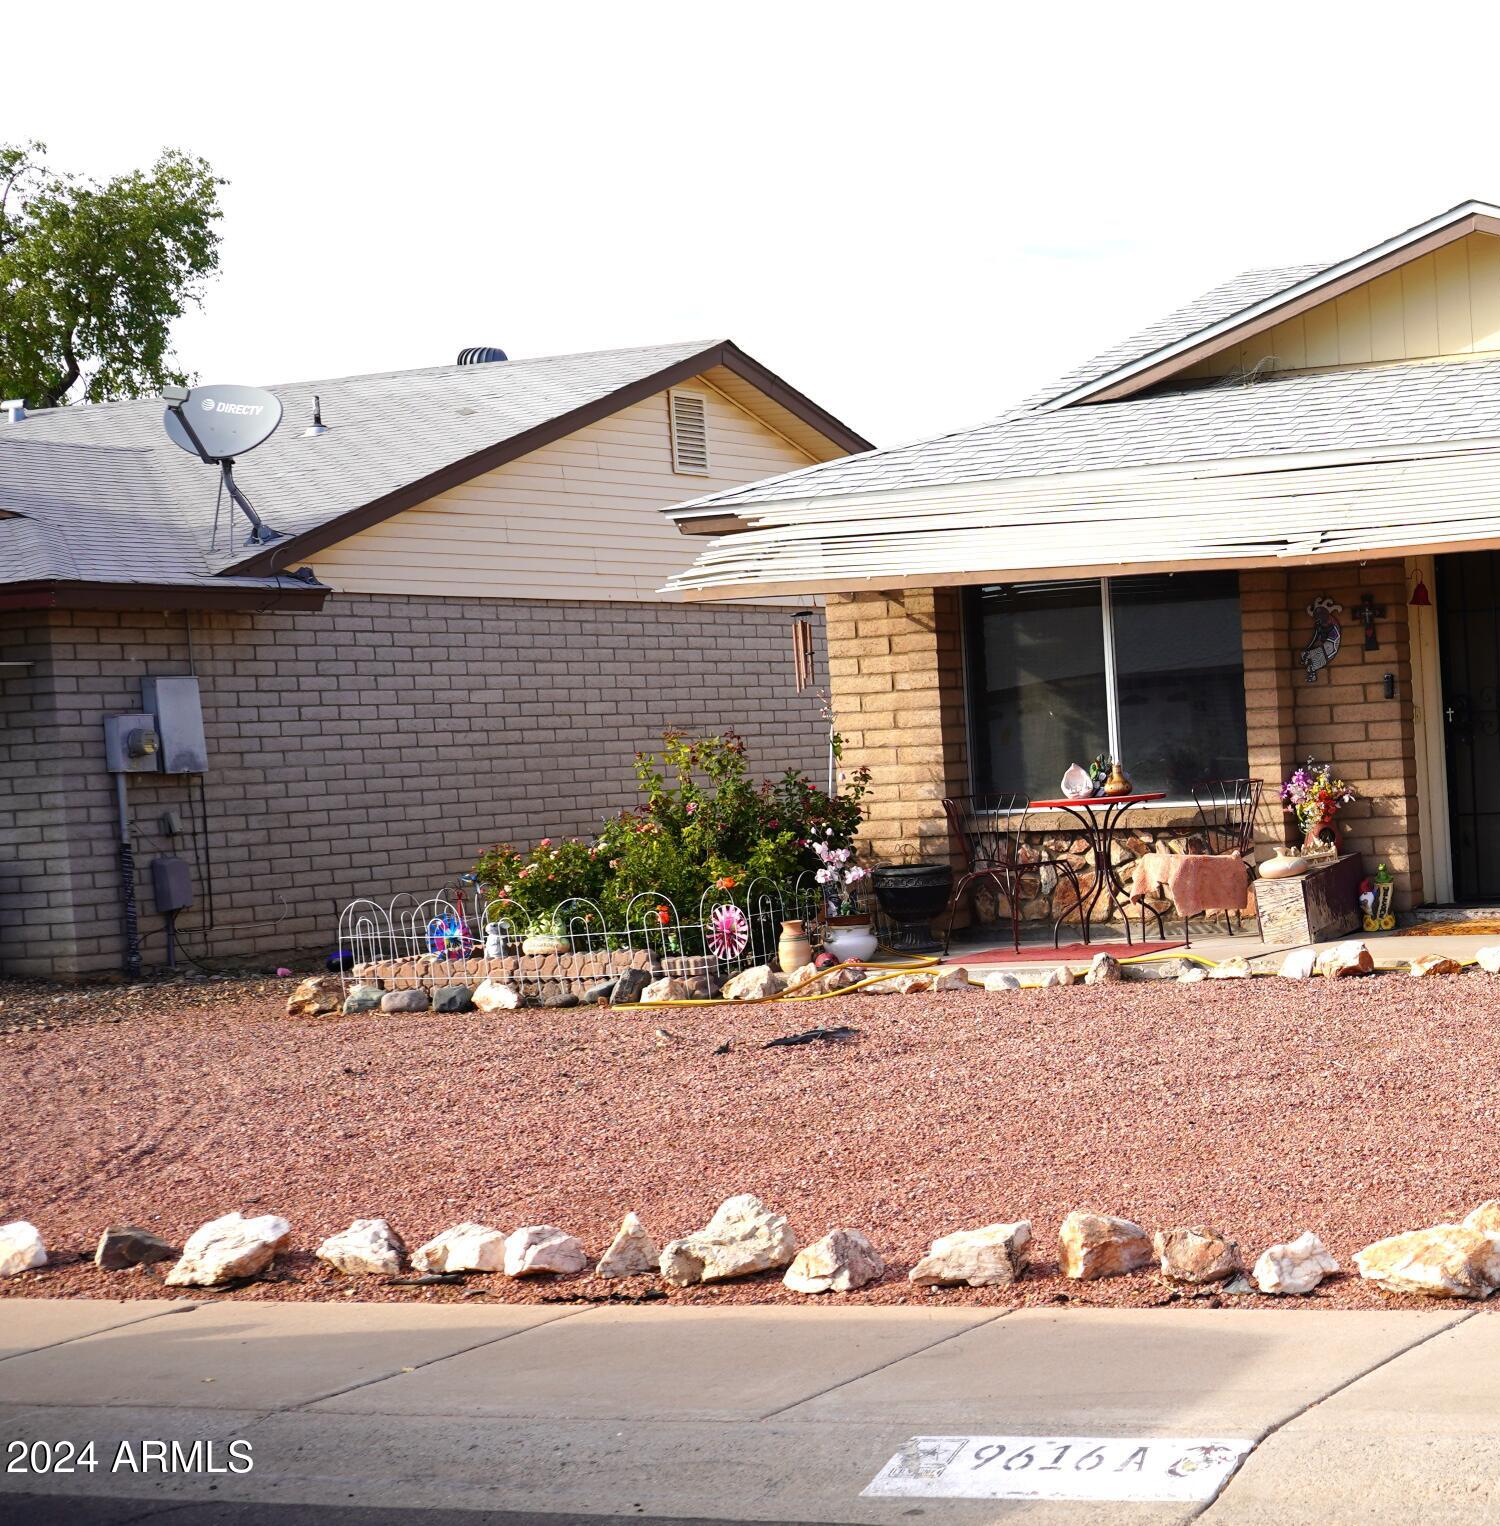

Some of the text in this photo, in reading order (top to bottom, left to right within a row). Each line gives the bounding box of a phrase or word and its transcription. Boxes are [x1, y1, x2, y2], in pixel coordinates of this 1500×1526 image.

[216, 402, 264, 416] DIRECTV
[971, 1444, 1150, 1472] 9616 A
